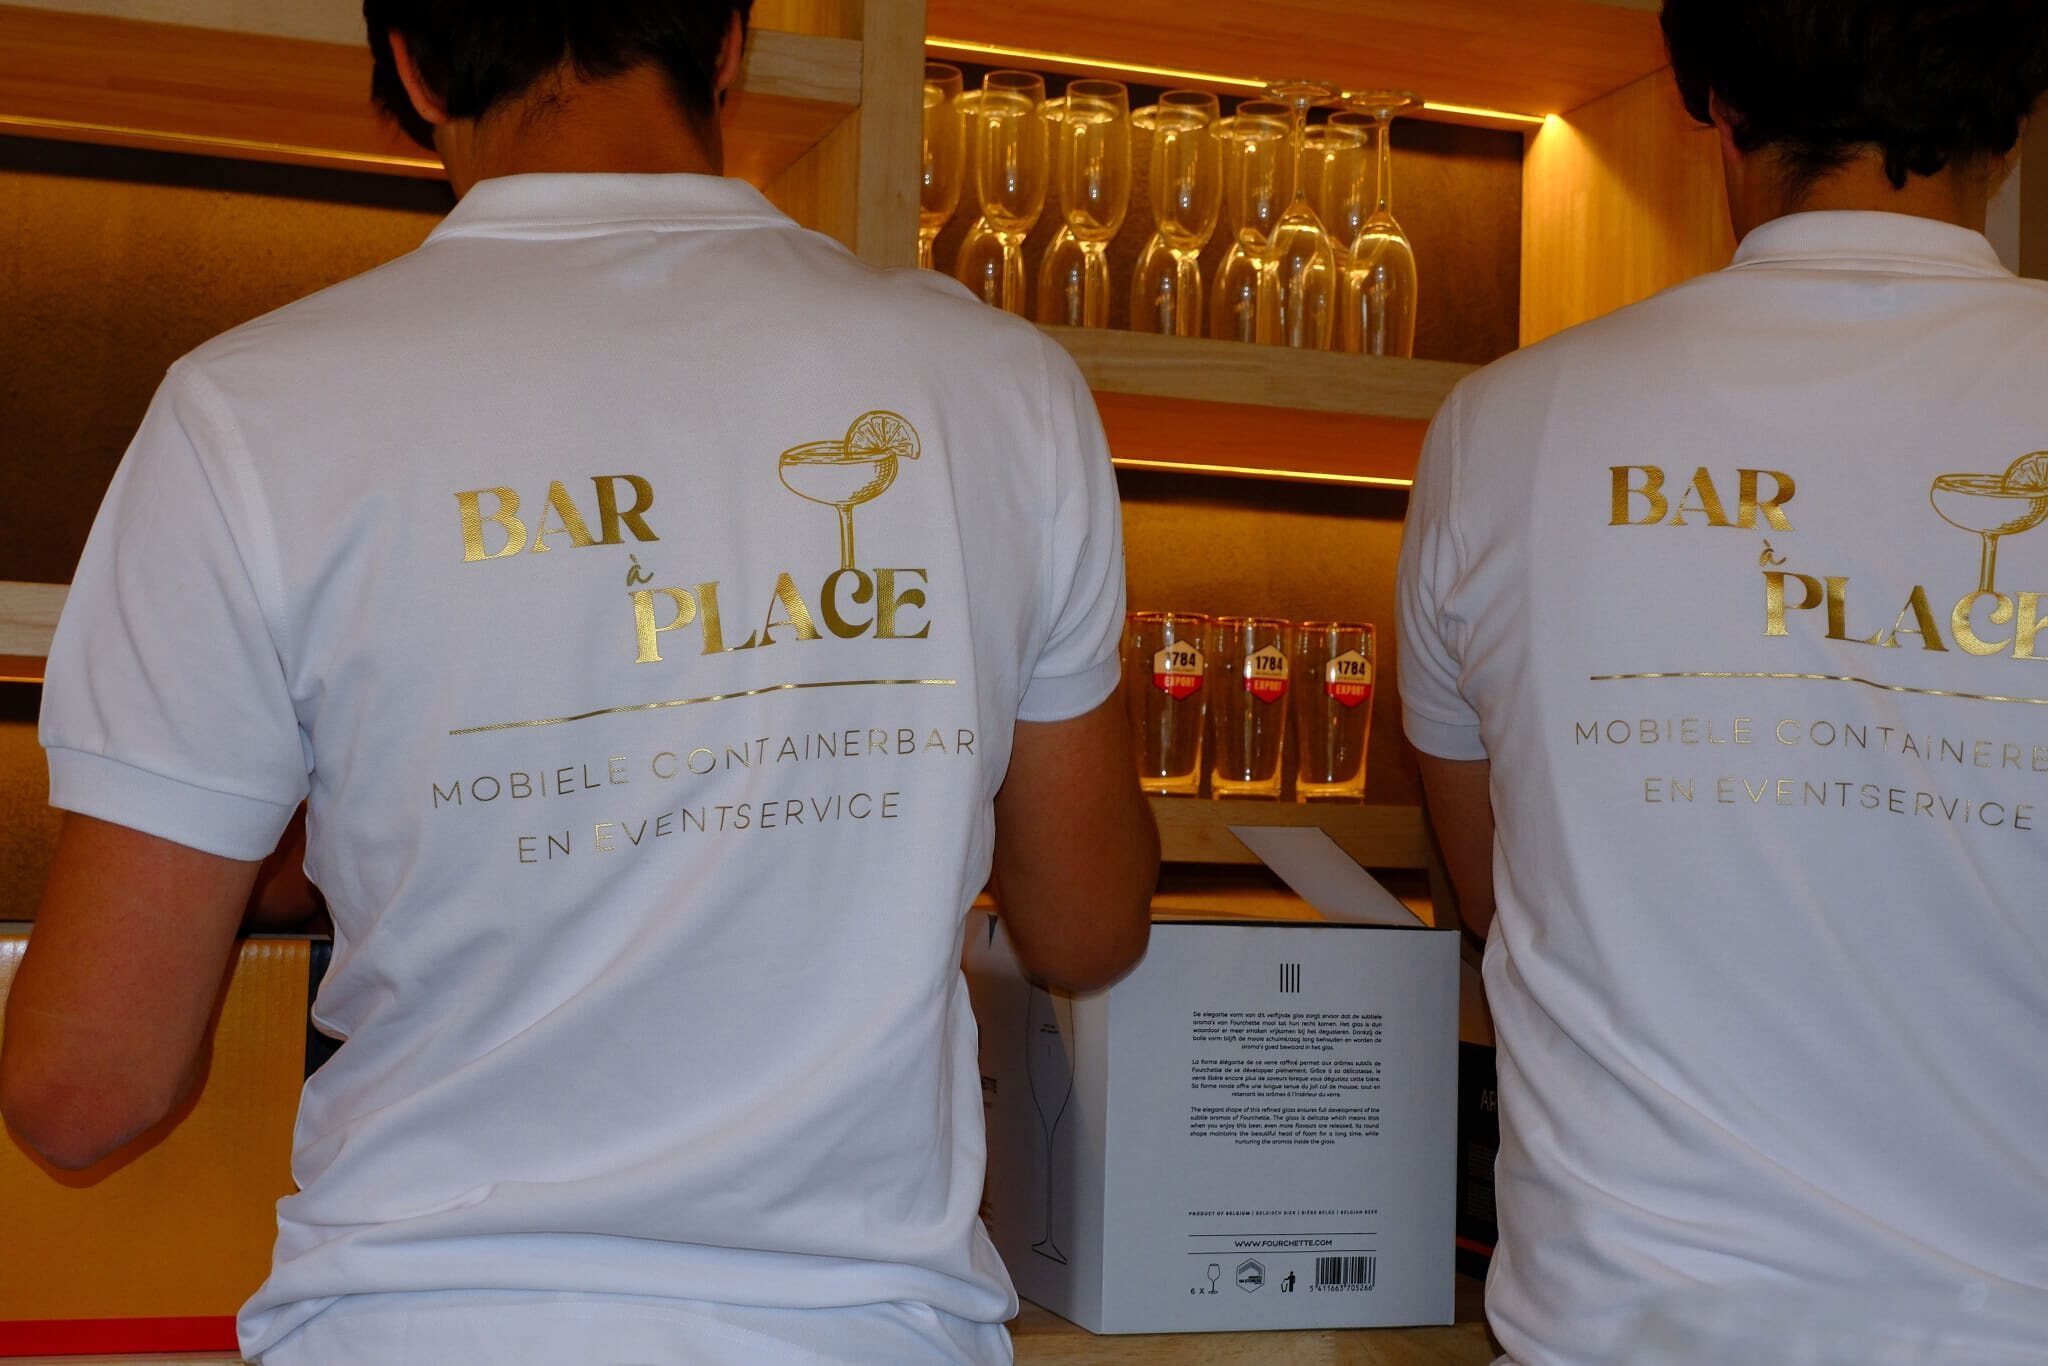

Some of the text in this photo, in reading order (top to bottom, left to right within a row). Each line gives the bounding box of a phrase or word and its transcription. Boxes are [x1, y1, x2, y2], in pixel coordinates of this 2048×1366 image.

[1608, 465, 1796, 531] BAR
[454, 474, 660, 563] BAR
[1760, 539, 1786, 567] à
[626, 555, 654, 586] à
[627, 568, 932, 664] PLACE
[1256, 655, 1283, 671] 1784
[1337, 661, 1365, 676] 1784
[1164, 676, 1195, 688] EXPORT
[1254, 680, 1282, 691] EXPORT
[1335, 685, 1365, 696] EXPORT
[1575, 717, 1754, 745] MOBIELE
[432, 728, 976, 809] MOBIELE CONTAINERBAR
[1644, 778, 2033, 831] EN EVENTSERVICE
[518, 792, 901, 863] EN EVENTSERVICE
[1234, 1239, 1333, 1248] WWW.FOURCHETTE.COM
